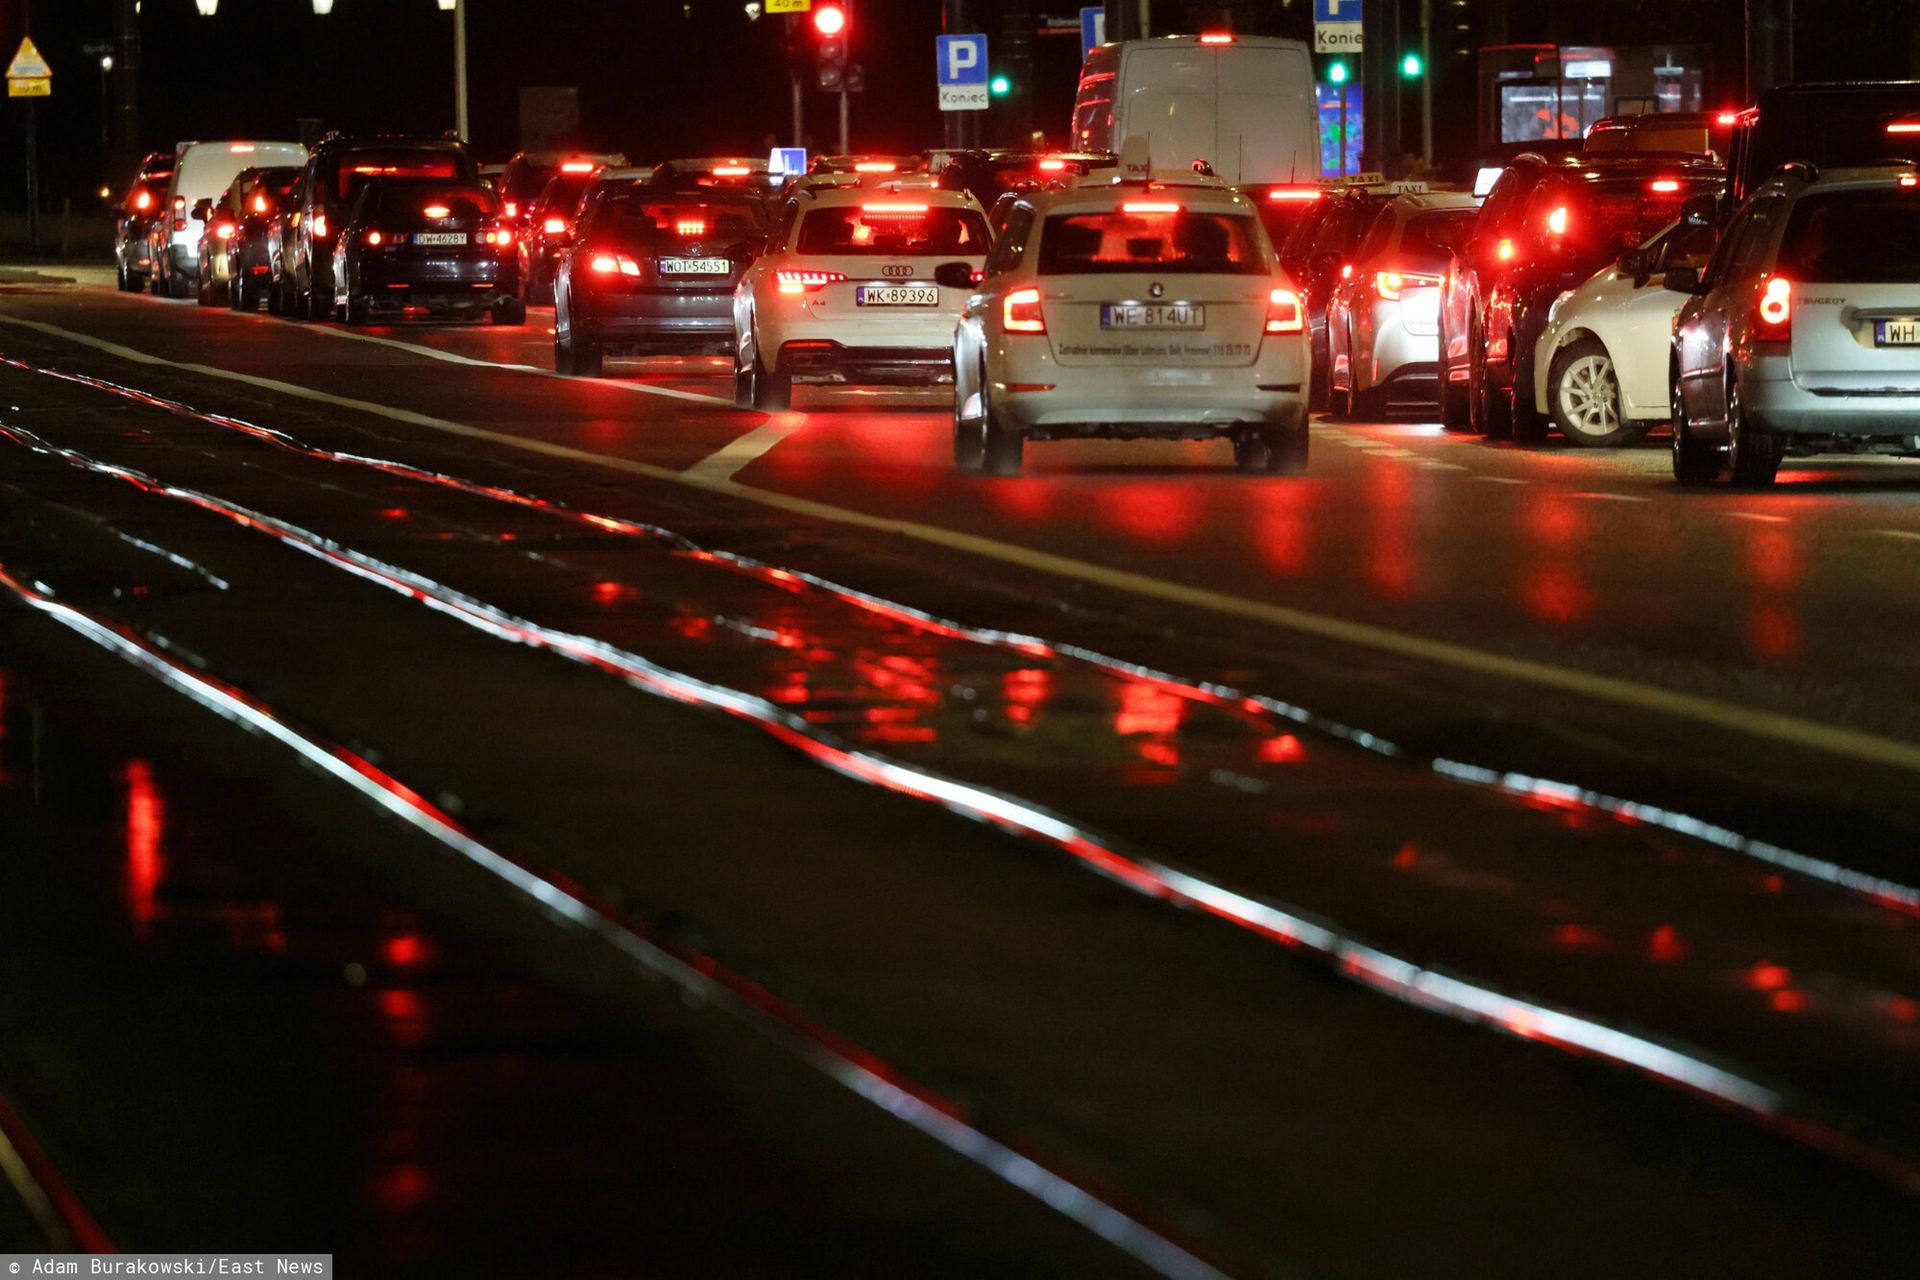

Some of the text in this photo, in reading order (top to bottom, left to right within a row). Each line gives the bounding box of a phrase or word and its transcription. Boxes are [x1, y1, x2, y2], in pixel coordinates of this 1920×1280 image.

[1318, 30, 1363, 44] Konie
[948, 40, 977, 79] P
[942, 92, 986, 103] Koniec
[1348, 174, 1380, 183] TAXI
[1397, 185, 1423, 194] TAXI
[667, 261, 726, 272] WOT 54551
[867, 290, 935, 303] WK 89396
[1114, 308, 1199, 324] WE 814UT
[1889, 325, 1915, 341] WH
